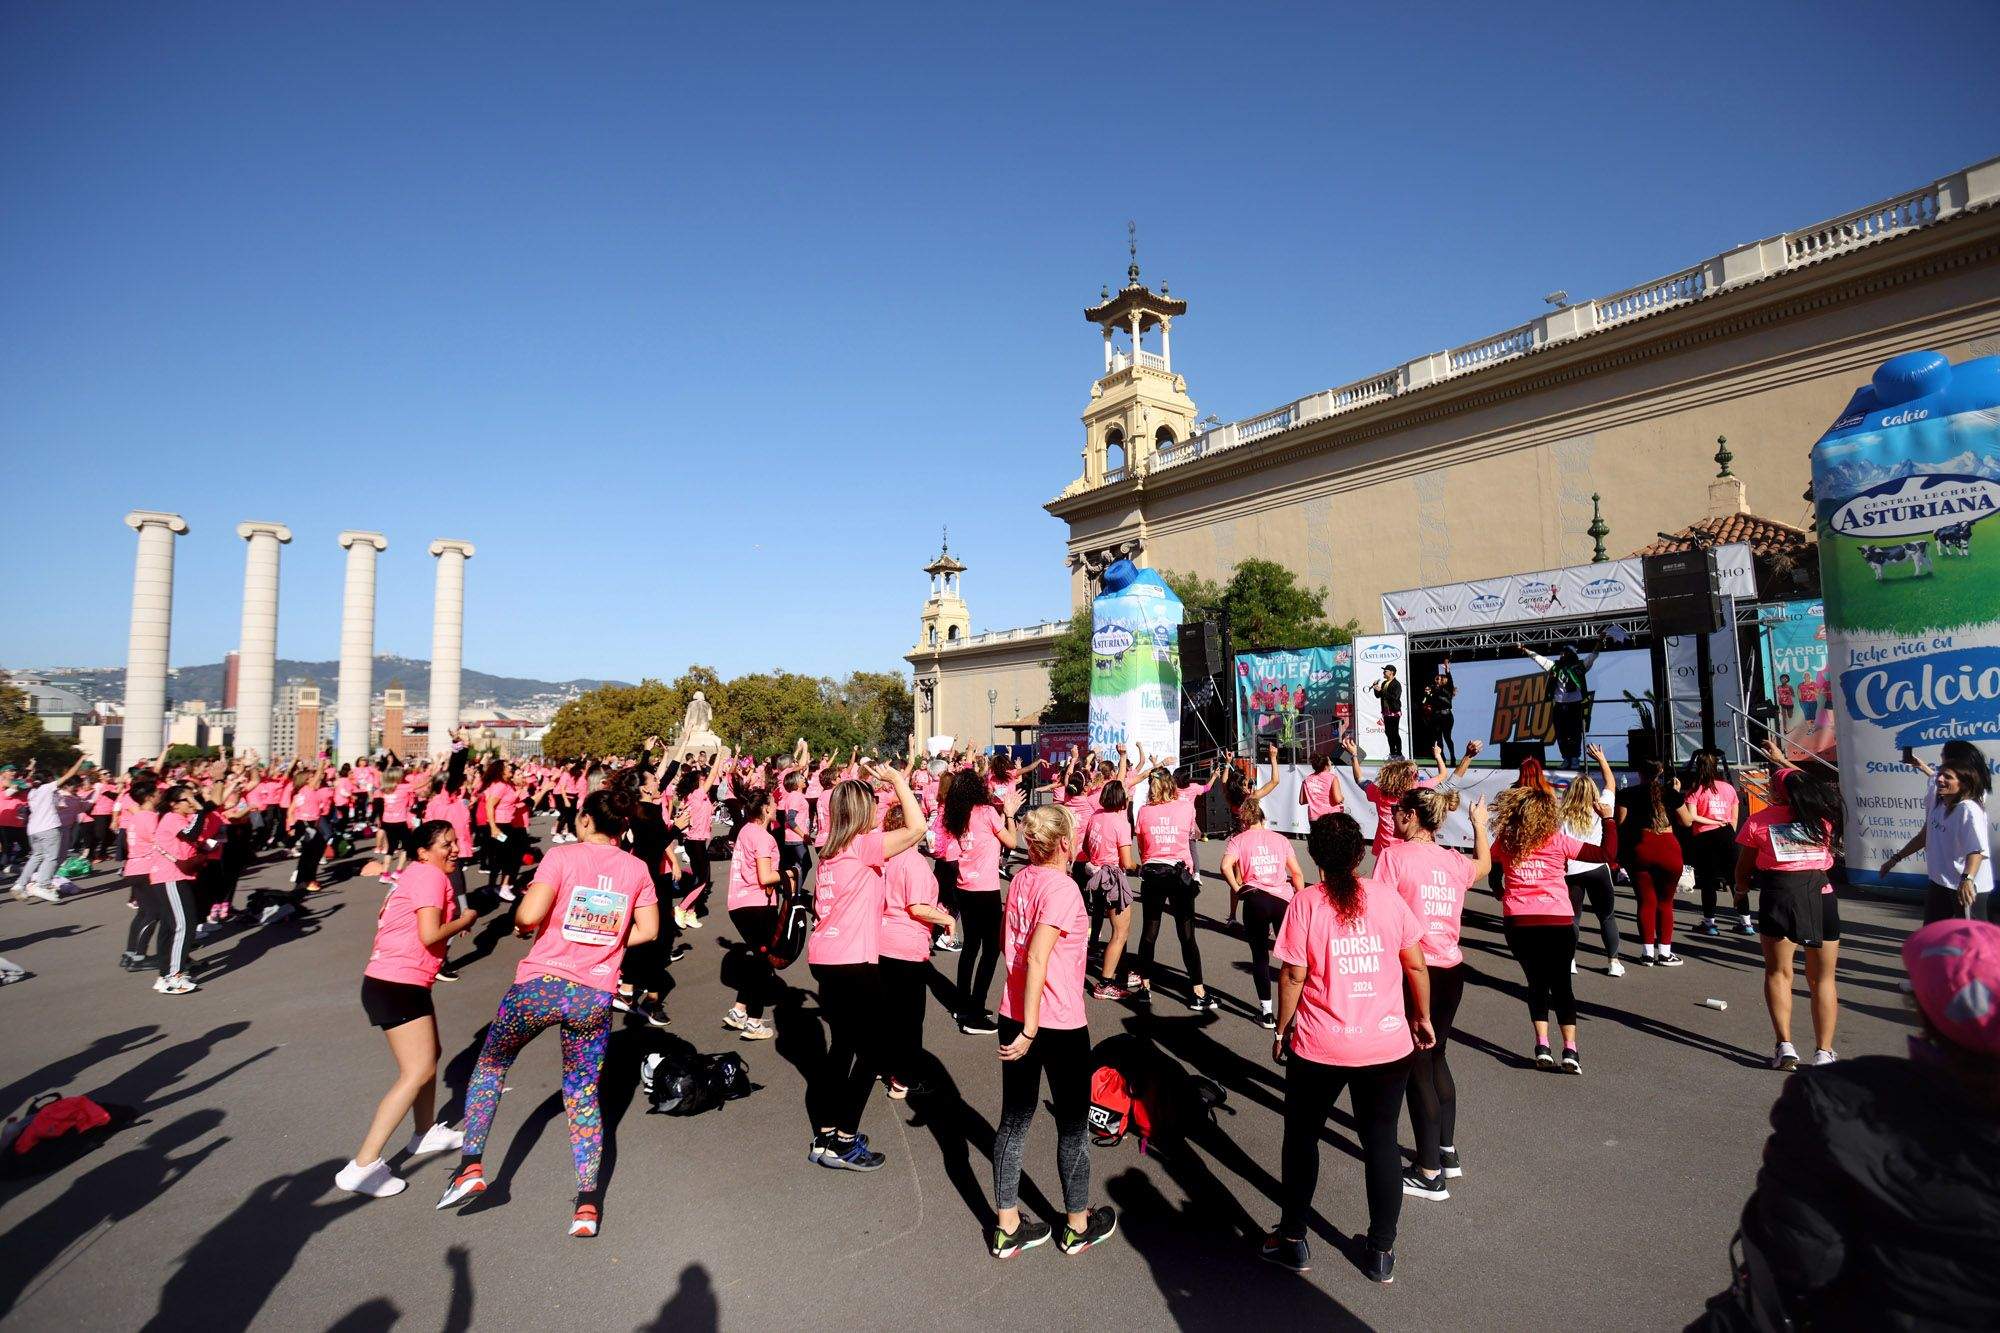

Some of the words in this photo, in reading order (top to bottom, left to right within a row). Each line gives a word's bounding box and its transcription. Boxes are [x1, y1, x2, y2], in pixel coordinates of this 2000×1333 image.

[1881, 409, 1928, 427] calcio
[1864, 494, 1919, 511] CENTRAL
[1924, 485, 1987, 501] LECHERA
[1840, 493, 1996, 533] ASTURIANA
[1425, 604, 1457, 615] OYSHO
[1092, 637, 1130, 649] ASTURIANA
[1850, 645, 1888, 667] Leche
[1893, 641, 1927, 657] rica
[1932, 637, 1952, 648] en
[1855, 664, 2000, 720] Calcio
[1159, 816, 1170, 826] TU
[1868, 816, 1895, 827] LECHE
[1150, 825, 1180, 835] DORSAL
[1155, 834, 1177, 844] SUMA
[1258, 845, 1269, 856] TU
[597, 874, 612, 891] TU
[1432, 870, 1447, 885] TU
[1420, 884, 1457, 903] DORSAL
[1424, 900, 1453, 917] SUMA
[1331, 934, 1385, 957] DORSAL
[1338, 954, 1381, 975] SUMA
[1352, 980, 1373, 992] 2024
